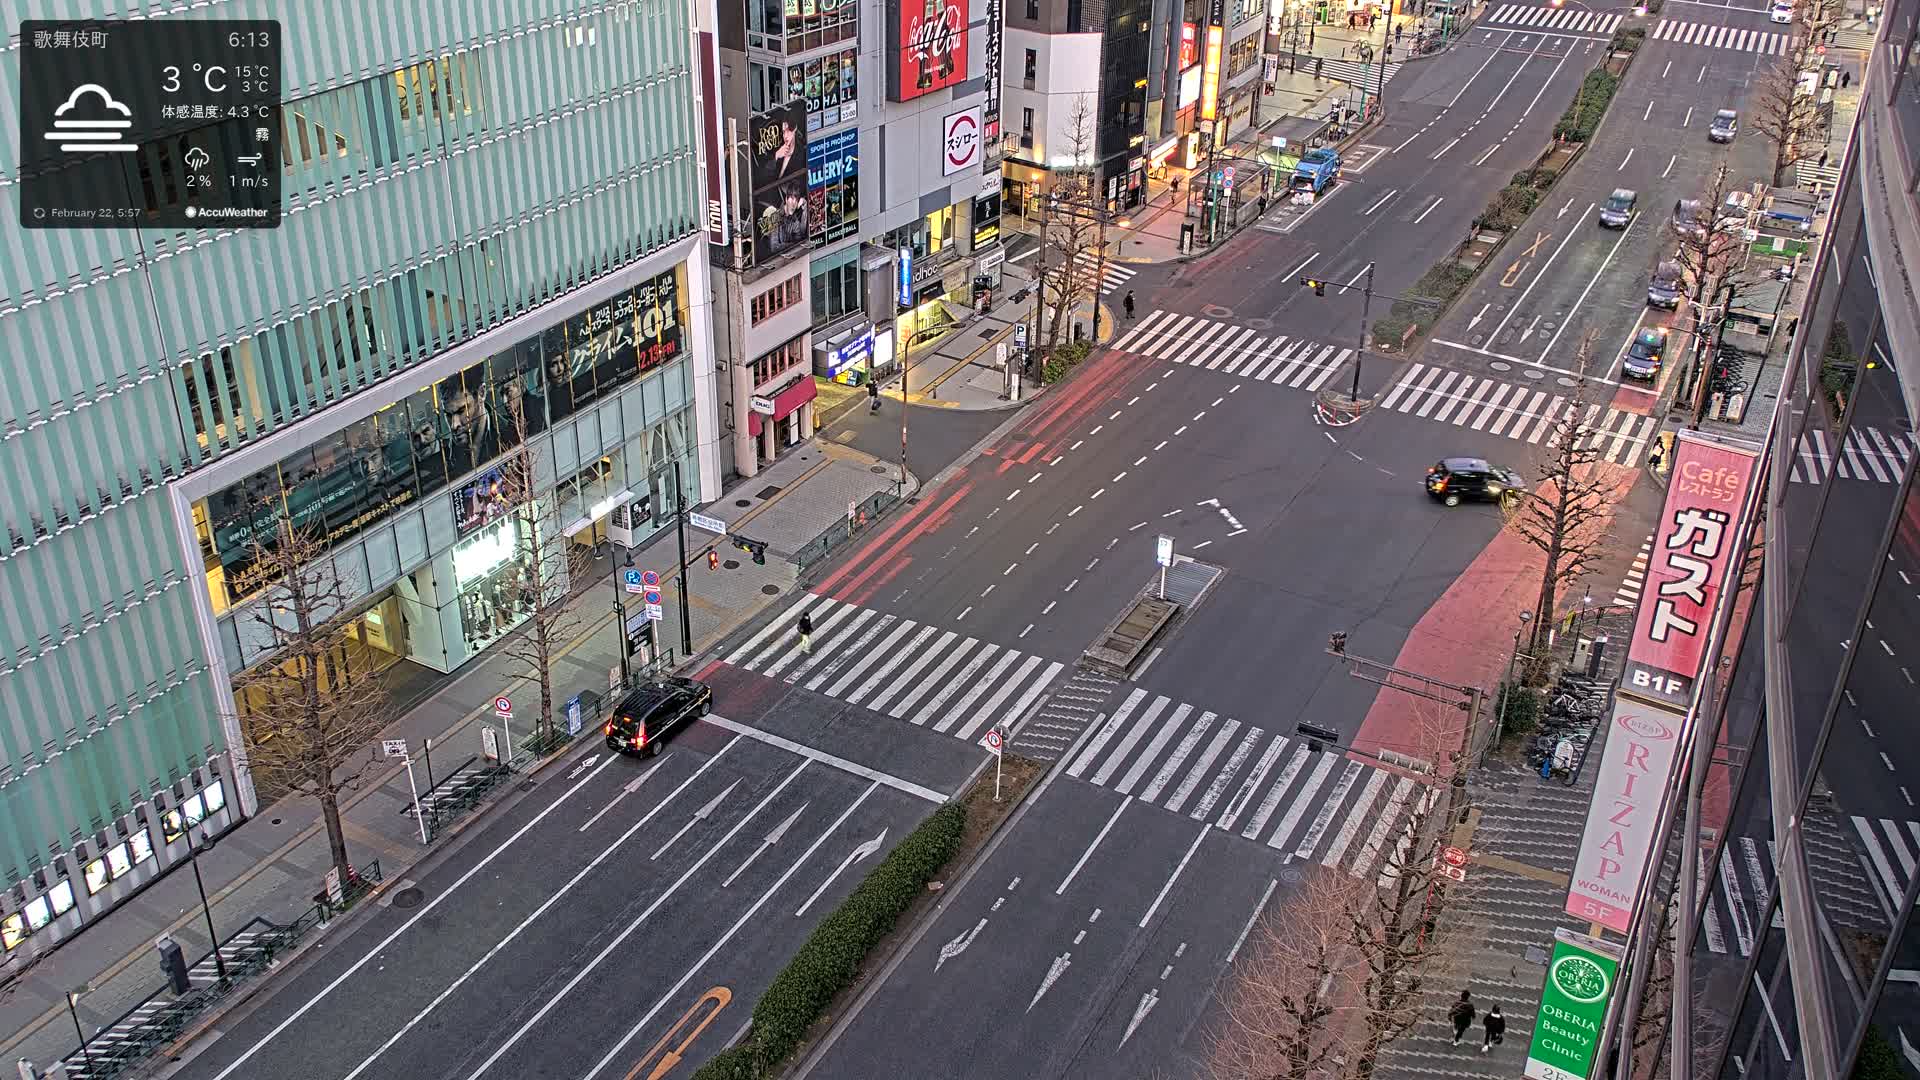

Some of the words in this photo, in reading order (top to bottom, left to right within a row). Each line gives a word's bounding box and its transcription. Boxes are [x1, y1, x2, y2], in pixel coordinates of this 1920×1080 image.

[908, 5, 960, 62] Coca-Cola
[810, 142, 830, 153] SPORTS
[947, 133, 978, 152] スシロー
[710, 200, 721, 232] MUJI
[1016, 326, 1024, 334] P
[1682, 461, 1738, 489] Café
[1679, 480, 1735, 502] レストラン
[1651, 509, 1728, 642] ガスト
[1632, 669, 1682, 695] B1F
[1598, 742, 1649, 881] RIZAP
[1577, 879, 1631, 904] WOMAN
[1584, 902, 1614, 921] 5F
[1558, 969, 1600, 991] OBERIA
[1542, 1004, 1597, 1033] OBERIA
[1542, 1020, 1590, 1047] Beauty
[1541, 1038, 1583, 1061] Clinic
